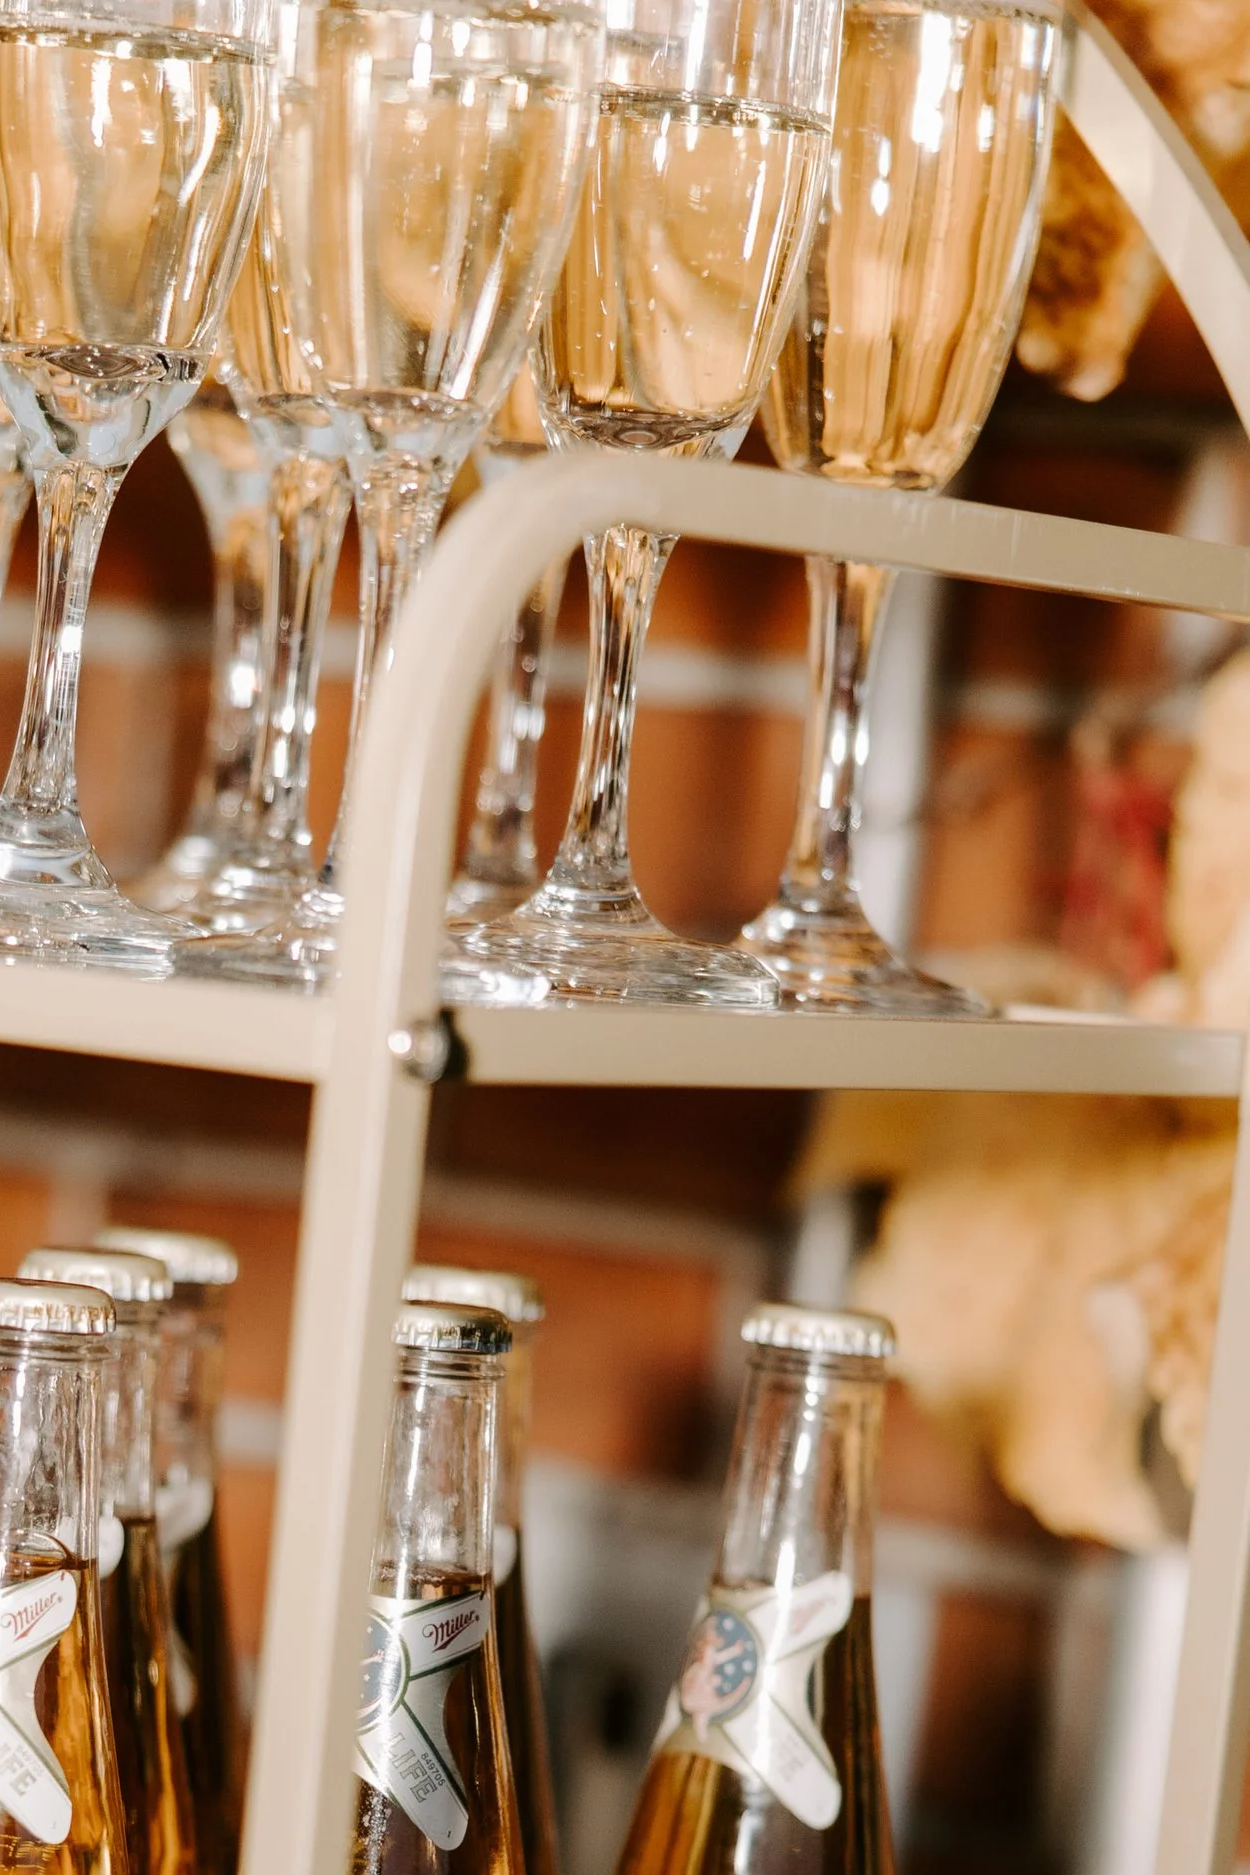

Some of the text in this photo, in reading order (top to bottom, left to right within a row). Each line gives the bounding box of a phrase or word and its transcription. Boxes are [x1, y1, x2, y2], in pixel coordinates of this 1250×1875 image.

[1, 1592, 62, 1641] Miller
[422, 1610, 480, 1652] Miller
[388, 1732, 438, 1804] LIFE
[421, 1752, 447, 1788] 849705
